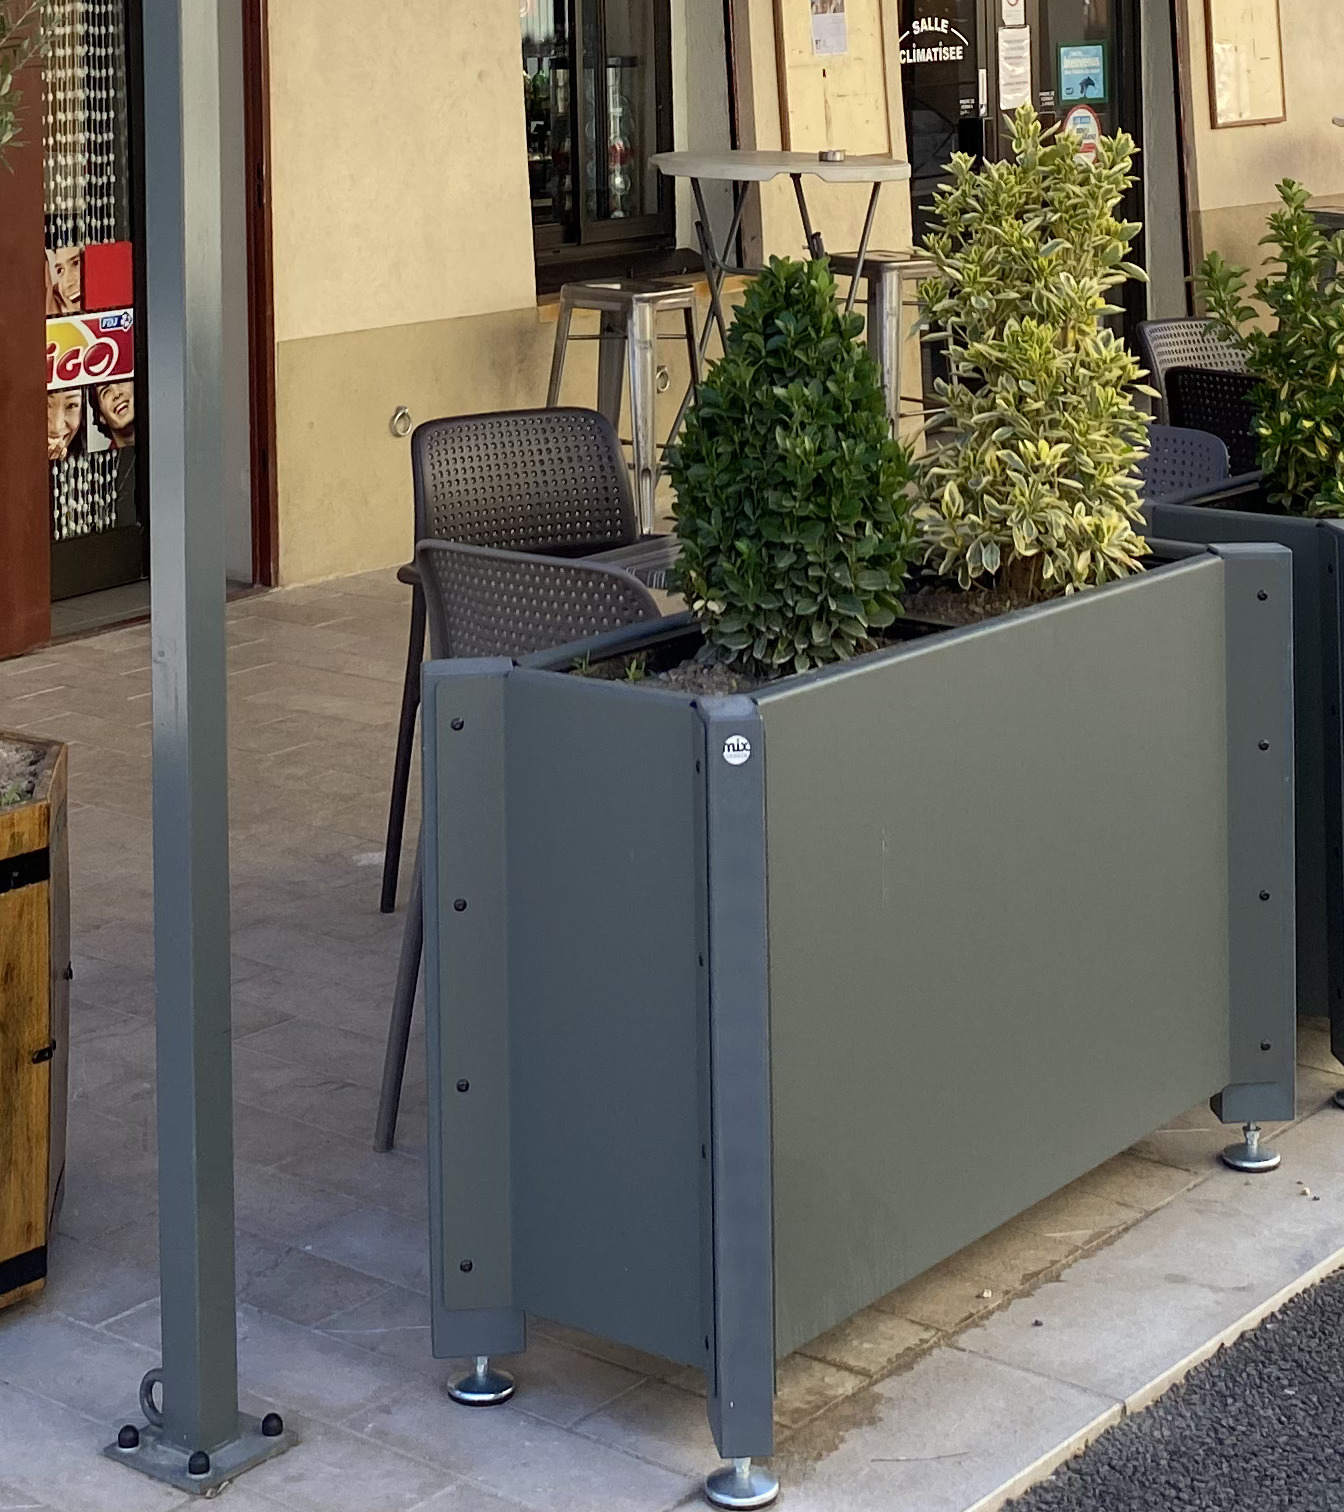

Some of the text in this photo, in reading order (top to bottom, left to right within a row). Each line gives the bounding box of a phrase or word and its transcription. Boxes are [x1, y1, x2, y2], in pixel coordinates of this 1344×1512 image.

[912, 17, 950, 35] SALLE
[102, 317, 119, 328] FDJ
[722, 737, 751, 753] mix
